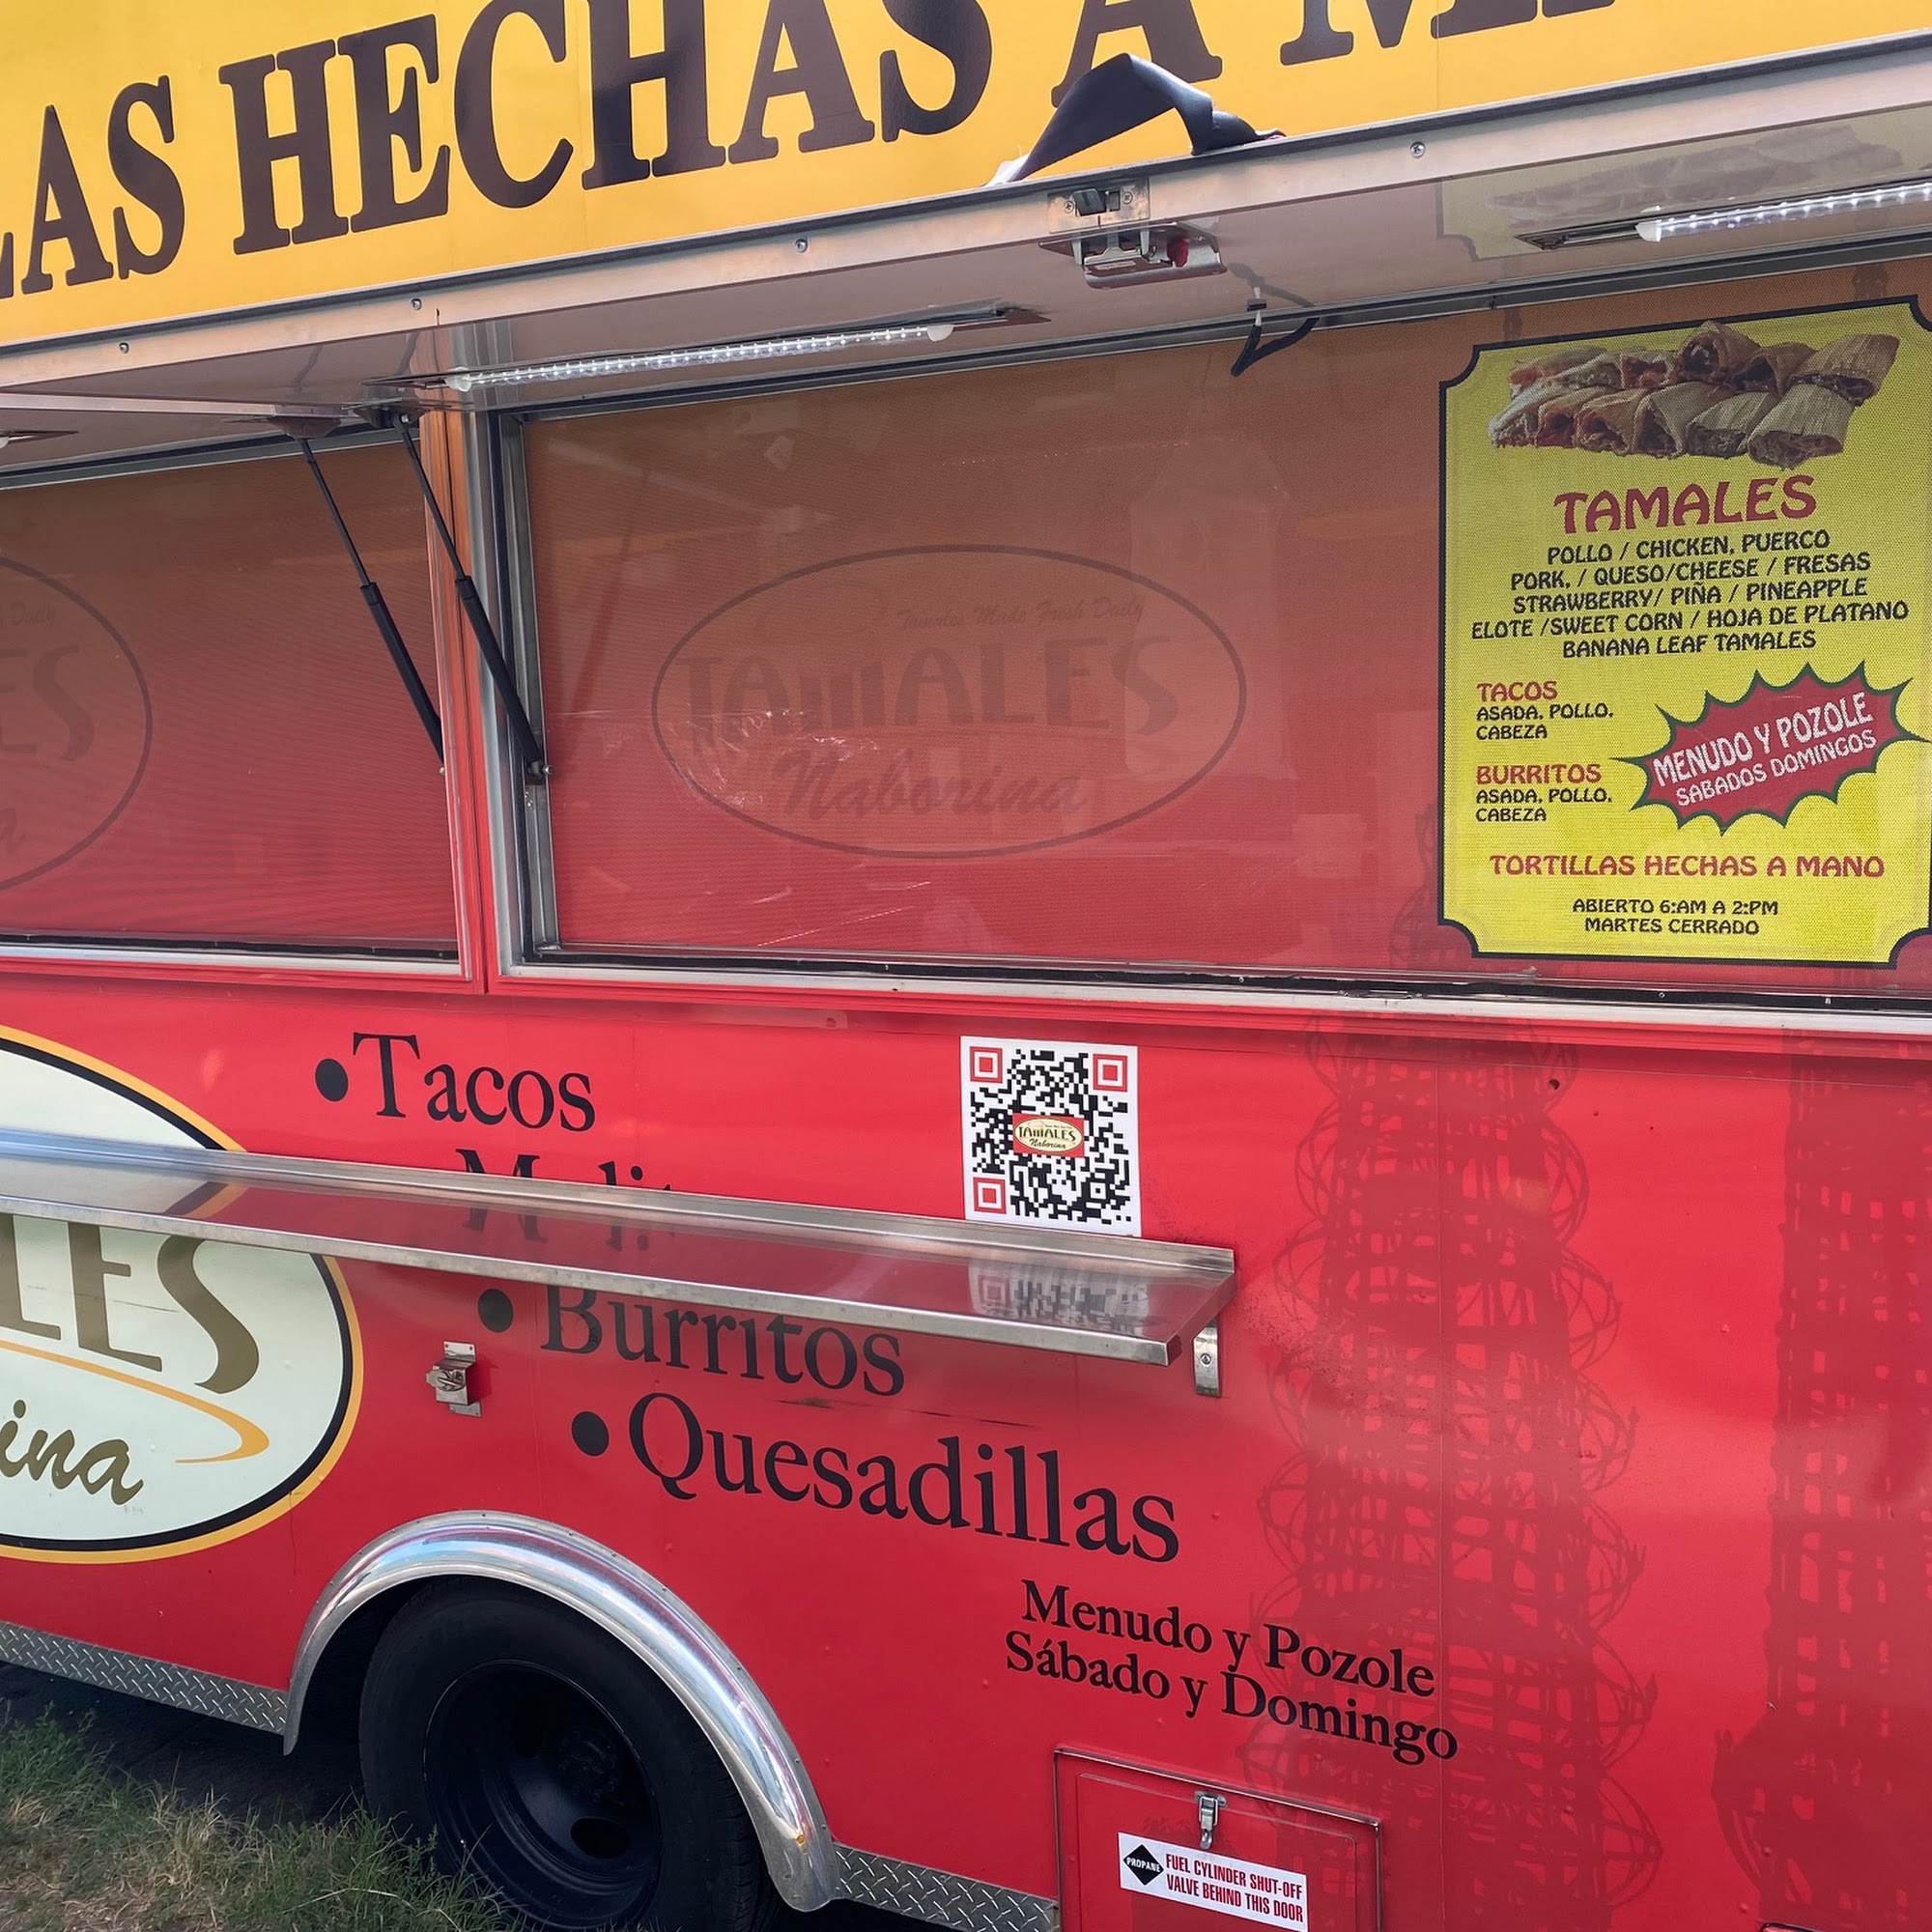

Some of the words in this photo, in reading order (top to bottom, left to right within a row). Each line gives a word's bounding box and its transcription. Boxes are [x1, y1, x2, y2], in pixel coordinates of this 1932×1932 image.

[0, 74, 185, 298] AS
[218, 0, 992, 255] HECHAS
[1552, 474, 1818, 534] TAMALES
[1548, 543, 1612, 565] POLLO
[1636, 536, 1735, 559] CHICKEN,
[1742, 529, 1831, 554] PUERCO
[1511, 570, 1571, 590] PORK,
[1594, 558, 1758, 586] QUESO/CHEESE
[1784, 552, 1870, 576] FRESAS
[1671, 582, 1721, 606] PIÑA
[1746, 578, 1868, 602] PINEAPPLE
[1471, 618, 1533, 639] ELOTE
[1625, 611, 1683, 632] CORN
[1707, 608, 1762, 628] HOJA
[1769, 606, 1797, 625] DE
[1804, 600, 1909, 623] PLATANO
[1563, 638, 1650, 658] BANANA
[1657, 634, 1708, 655] LEAF
[1714, 629, 1817, 652] TAMALES
[677, 636, 1179, 753] TAMALES
[1477, 680, 1558, 702] TACOS
[1476, 724, 1548, 740] CABEZA
[1653, 731, 1752, 786] MENUDO
[1754, 723, 1771, 754] Y
[1776, 692, 1874, 748] POZOLE
[772, 747, 1091, 820] Naborina
[1476, 763, 1602, 784] BURRITOS
[1676, 763, 1767, 808] SABADOS
[1771, 728, 1877, 778] DOMINGOS
[1476, 808, 1547, 822] CABEZA
[1490, 855, 1635, 876] TORTILLAS
[1644, 855, 1758, 877] HECHAS
[1767, 856, 1787, 877] A
[1796, 856, 1886, 878] MANO
[1573, 898, 1654, 913] ABIERTO
[1660, 899, 1707, 914] 6:AM
[1712, 900, 1725, 914] A
[1732, 900, 1779, 915] 2:PM
[1584, 917, 1662, 933] MARTES
[1667, 919, 1760, 935] CERRADO
[352, 1033, 596, 1132] Tacos
[1018, 1126, 1076, 1142] TAMALES
[541, 1284, 905, 1397] Burritos
[629, 1392, 1180, 1563] Quesadillas
[1020, 1578, 1213, 1655] Menudo
[1223, 1629, 1251, 1672] y
[1264, 1623, 1435, 1697] Pozole
[1005, 1631, 1170, 1699] Sábado
[1180, 1676, 1208, 1719] y
[1220, 1671, 1459, 1766] Domingo
[1125, 1857, 1161, 1873] PROPANE
[1166, 1854, 1190, 1873] FUEL
[1194, 1861, 1246, 1887] CYLINDER
[1250, 1876, 1302, 1900] SHUT-OFF
[1167, 1874, 1200, 1896] VALVE
[1202, 1883, 1241, 1907] BEHIND
[1245, 1892, 1270, 1914] THIS
[1273, 1901, 1303, 1922] DOOR
